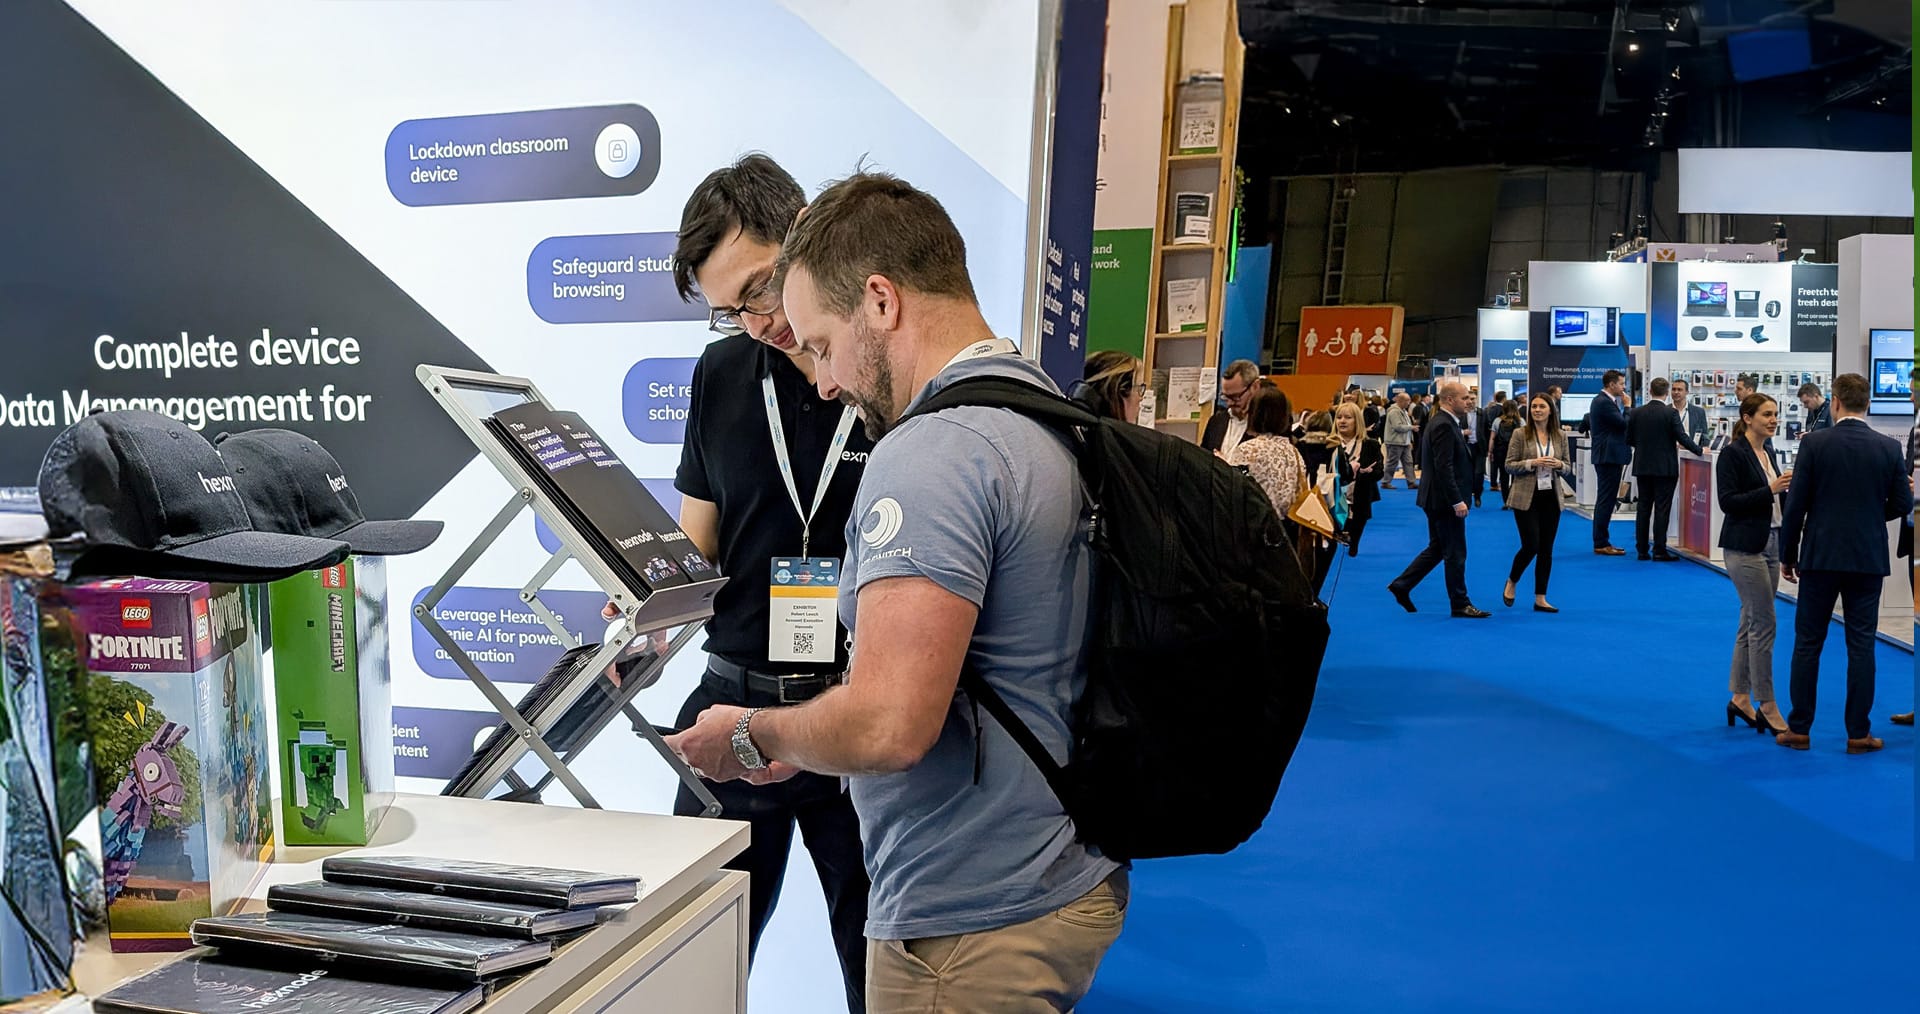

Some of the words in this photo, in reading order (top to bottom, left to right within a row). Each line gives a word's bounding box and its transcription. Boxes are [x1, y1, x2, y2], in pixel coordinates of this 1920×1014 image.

[409, 141, 486, 161] Lockdown
[489, 136, 569, 157] classroom
[410, 166, 458, 184] device
[1092, 243, 1113, 254] and
[552, 256, 634, 279] Safeguard
[637, 254, 679, 273] stud
[1095, 258, 1121, 269] work
[553, 282, 625, 301] browsing
[94, 331, 238, 379] Complete
[249, 327, 361, 367] device
[648, 382, 675, 398] Set
[319, 384, 372, 422] for
[509, 422, 526, 432] The
[519, 425, 551, 442] Standard
[528, 442, 541, 451] for
[538, 434, 563, 448] Unified
[536, 446, 568, 461] Endpoint
[545, 453, 587, 470] Management
[615, 528, 655, 551] hexnode
[656, 527, 688, 543] hexnode
[122, 605, 151, 621] LEGO
[208, 585, 245, 648] FORTNITE
[433, 606, 497, 625] Leverage
[328, 592, 345, 673] MINECRAFT
[444, 628, 474, 642] enie
[476, 629, 492, 642] AI
[496, 629, 516, 644] for
[89, 632, 187, 661] FORTNITE
[435, 648, 515, 664] aumation
[130, 662, 151, 671] 77071
[240, 968, 329, 1009] hexnode
